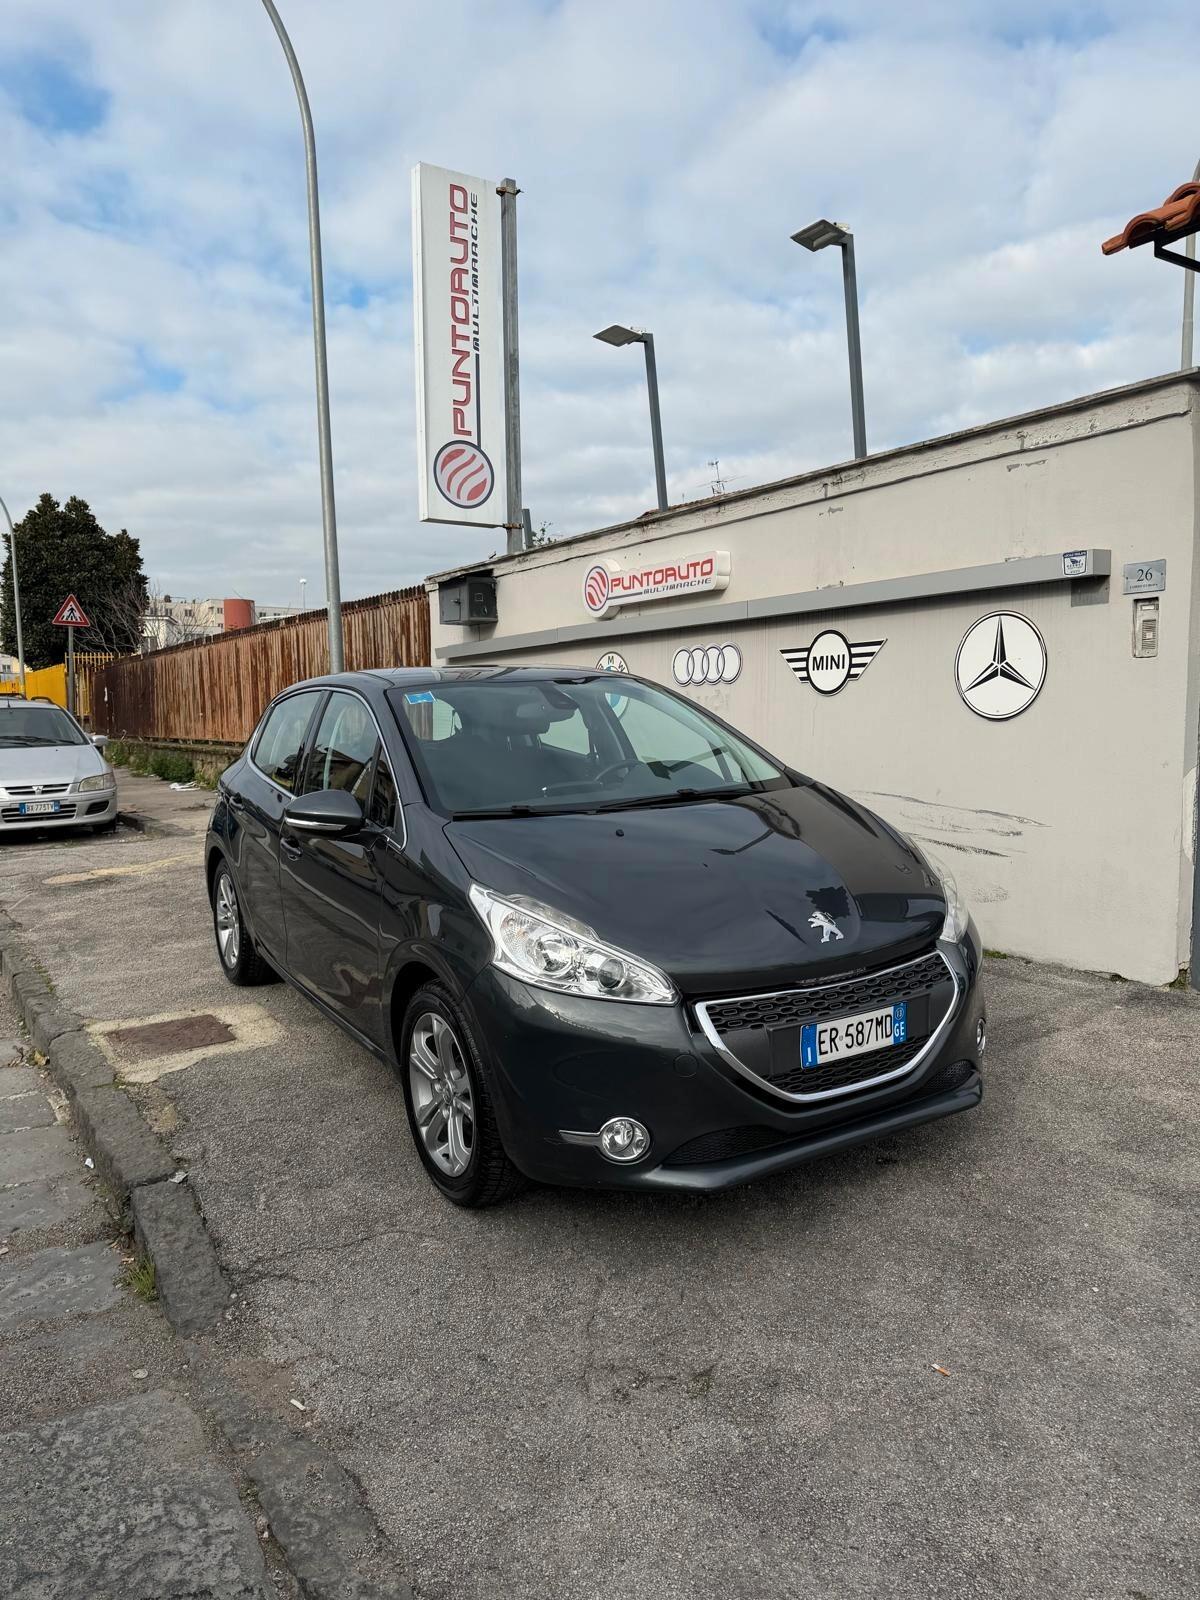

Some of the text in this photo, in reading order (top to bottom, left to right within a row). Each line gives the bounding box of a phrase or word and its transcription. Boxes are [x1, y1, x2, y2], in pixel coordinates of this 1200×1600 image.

[470, 192, 480, 352] MULTIMARCHE
[449, 183, 472, 437] PUNTOAUTO
[610, 558, 713, 593] PUNTOAUTO
[1136, 567, 1153, 582] 26
[643, 577, 712, 595] MULTIMARCHE
[812, 653, 846, 672] MINI
[894, 1021, 905, 1037] GE
